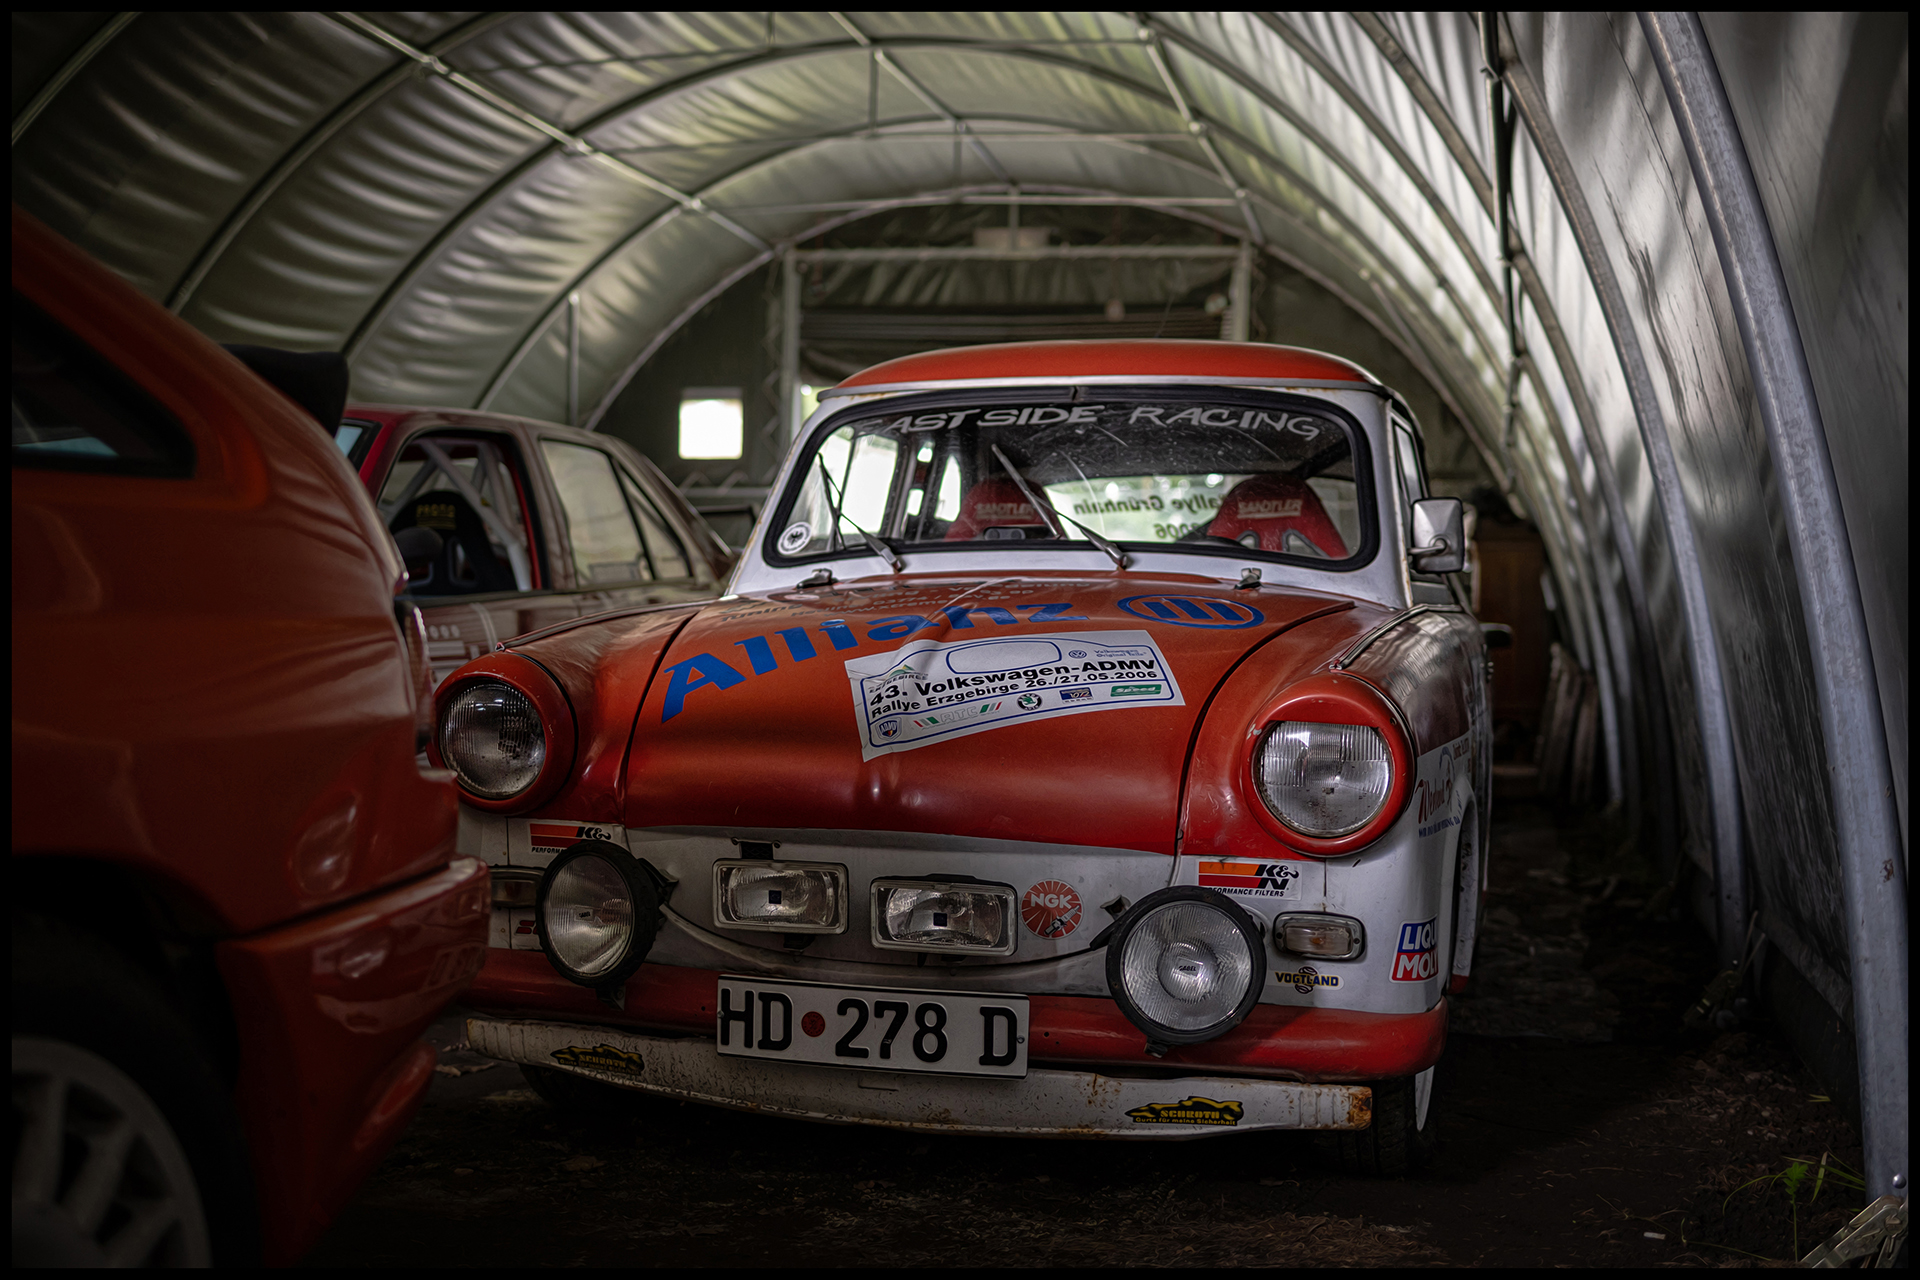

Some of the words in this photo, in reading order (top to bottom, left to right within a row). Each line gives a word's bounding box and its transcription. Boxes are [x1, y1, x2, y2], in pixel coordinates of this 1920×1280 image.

[976, 405, 1105, 427] SIDE
[1129, 406, 1320, 440] RACING
[662, 603, 1091, 723] Allianz
[870, 684, 908, 706] 43.
[914, 659, 1155, 696] Volkswagen-ADMV
[871, 700, 921, 719] Rallye
[926, 682, 1020, 707] Erzgebirge
[1025, 671, 1158, 688] 26./27.05.2006
[1030, 893, 1072, 909] NGK
[1275, 972, 1339, 987] VOGTLAND
[720, 988, 793, 1051] HD
[835, 998, 948, 1063] 278
[979, 1006, 1018, 1067] D
[1158, 1116, 1170, 1124] für
[1196, 1118, 1236, 1126] Sicherheit
[1160, 1110, 1220, 1119] SCHROTH
